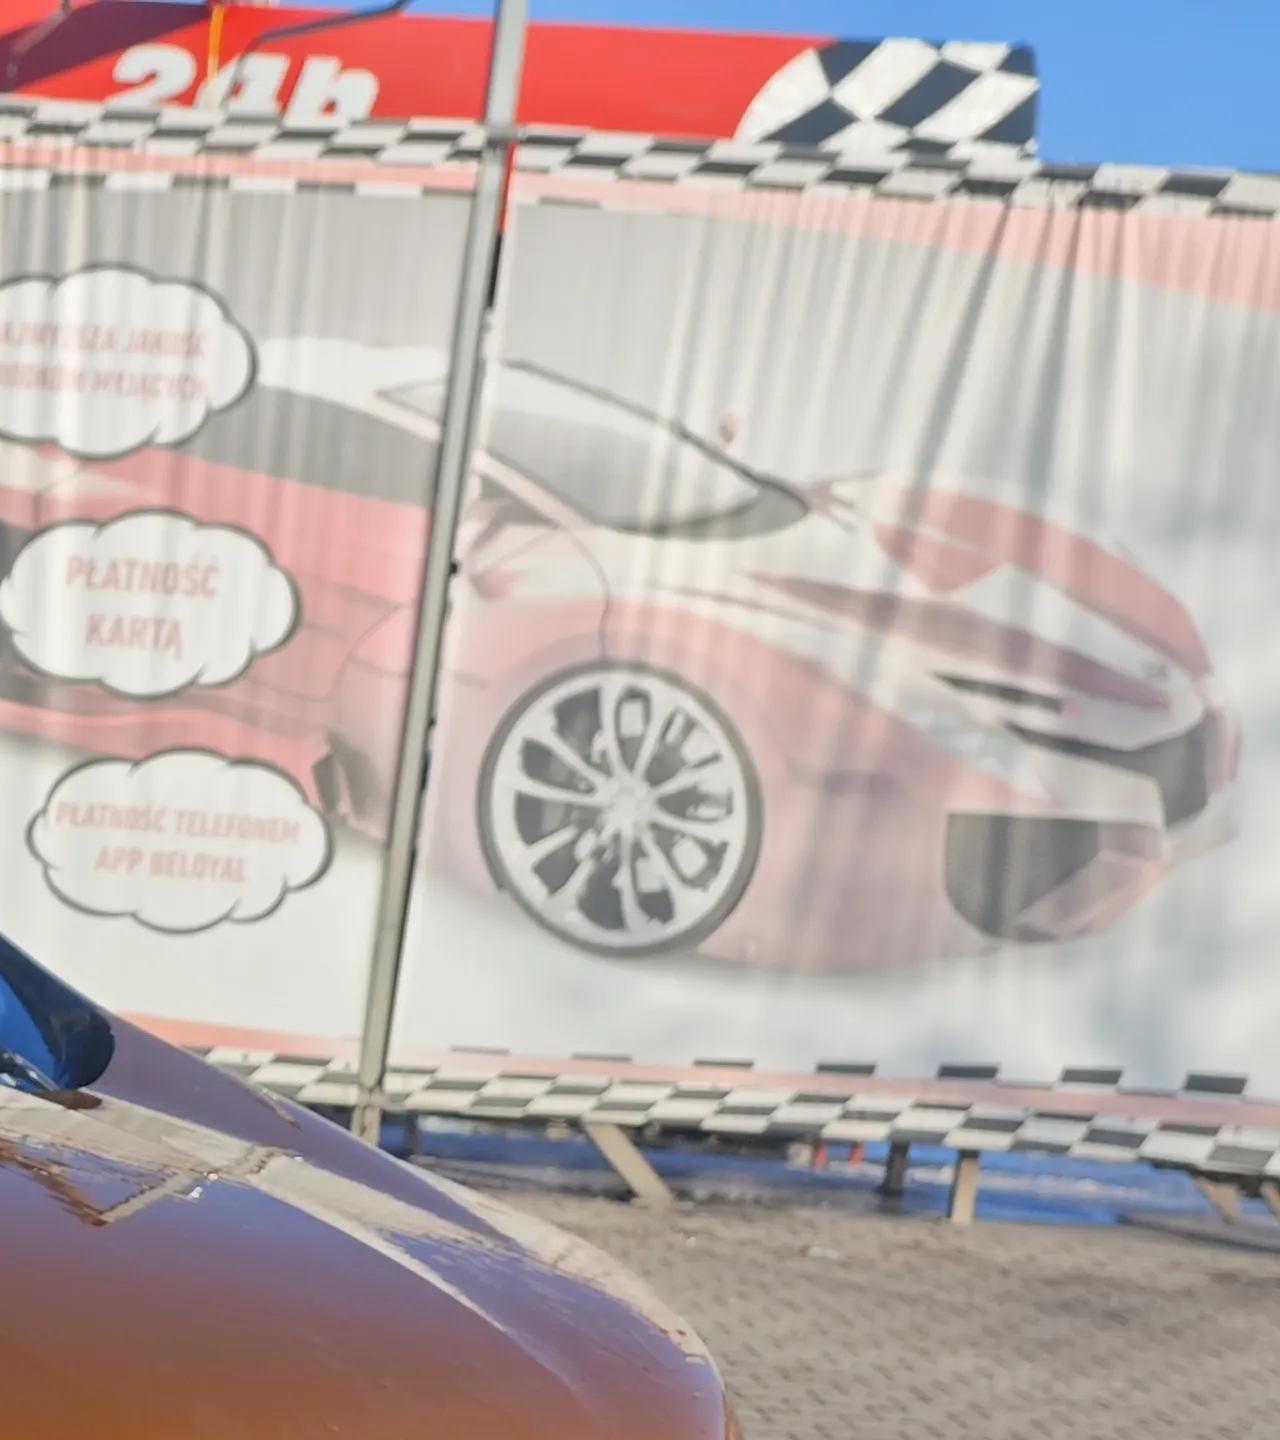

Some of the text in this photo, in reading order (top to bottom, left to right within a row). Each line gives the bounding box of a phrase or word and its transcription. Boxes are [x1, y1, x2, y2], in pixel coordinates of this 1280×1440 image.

[64, 552, 221, 600] PŁATNOŚĆ
[86, 613, 184, 660] KARTĄ
[94, 845, 143, 874] APP
